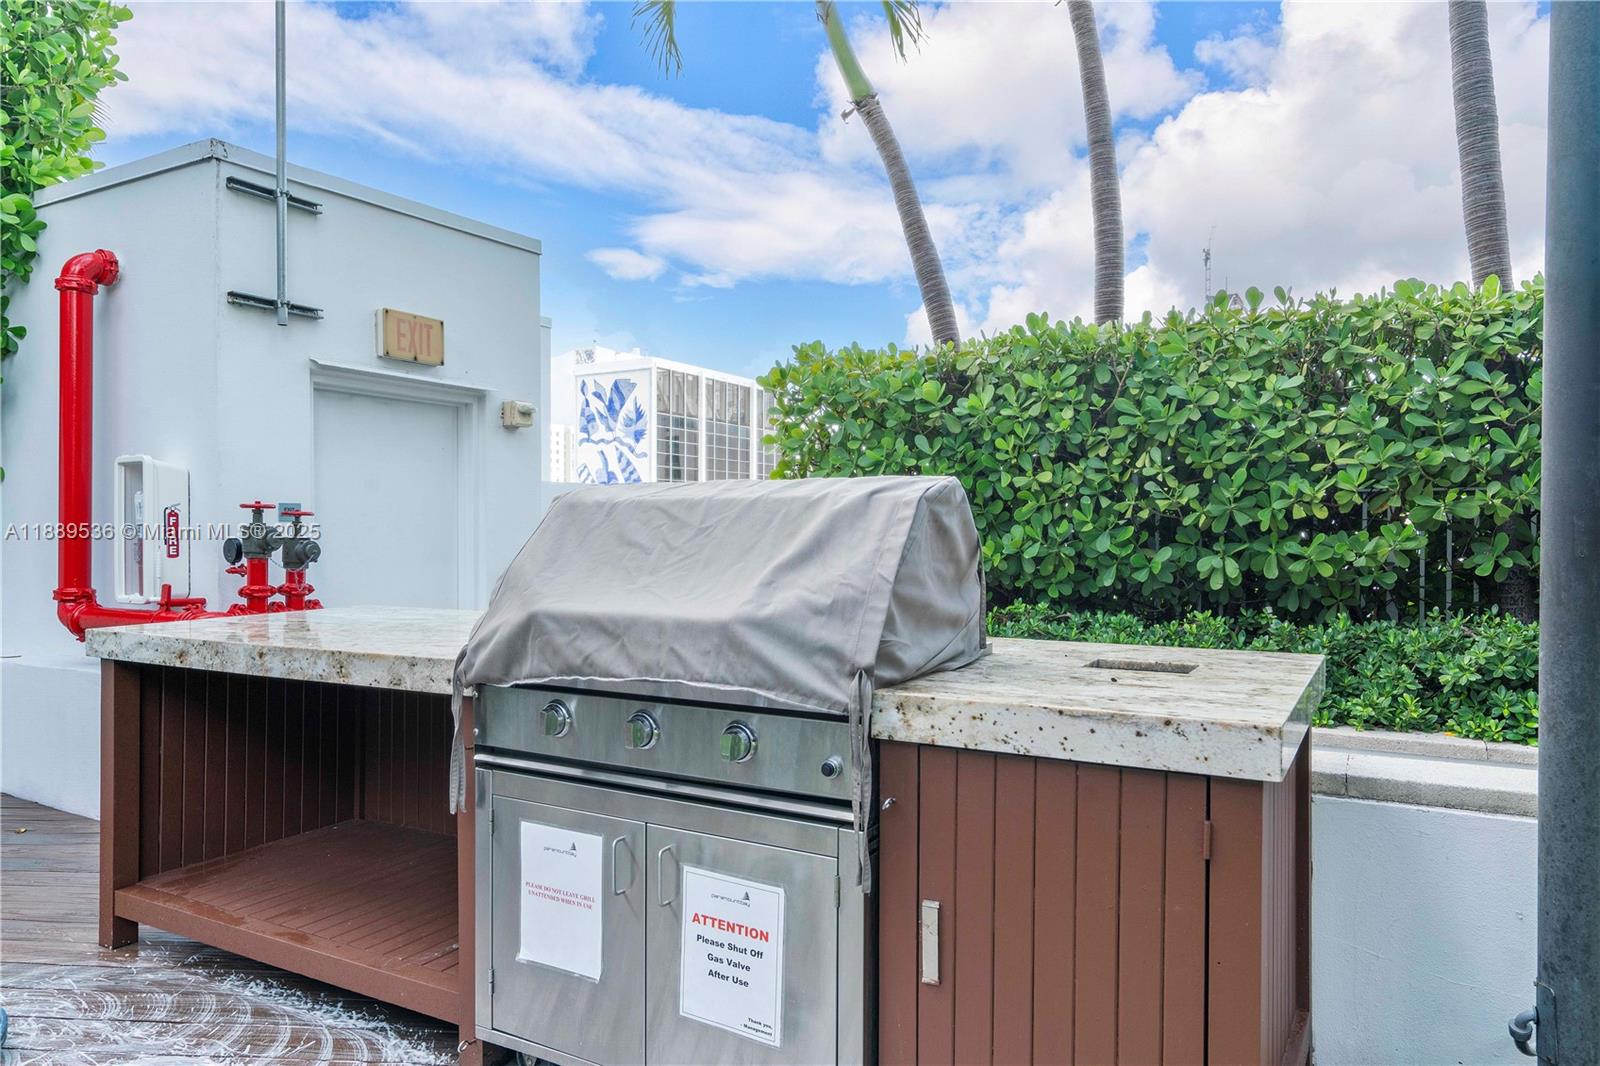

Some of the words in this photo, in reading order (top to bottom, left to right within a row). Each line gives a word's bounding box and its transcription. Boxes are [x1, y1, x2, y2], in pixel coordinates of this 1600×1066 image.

[396, 318, 433, 357] EXIT
[526, 882, 542, 890] PLEASE
[562, 890, 579, 899] LEAVE
[528, 890, 560, 902] UNATTENDED
[692, 912, 769, 943] ATTENTION
[696, 934, 725, 949] Please
[727, 942, 748, 955] Shut
[750, 949, 764, 959] Off
[707, 953, 724, 965] Gas
[726, 957, 751, 972] Valve
[708, 969, 730, 982] After
[732, 975, 750, 988] Use
